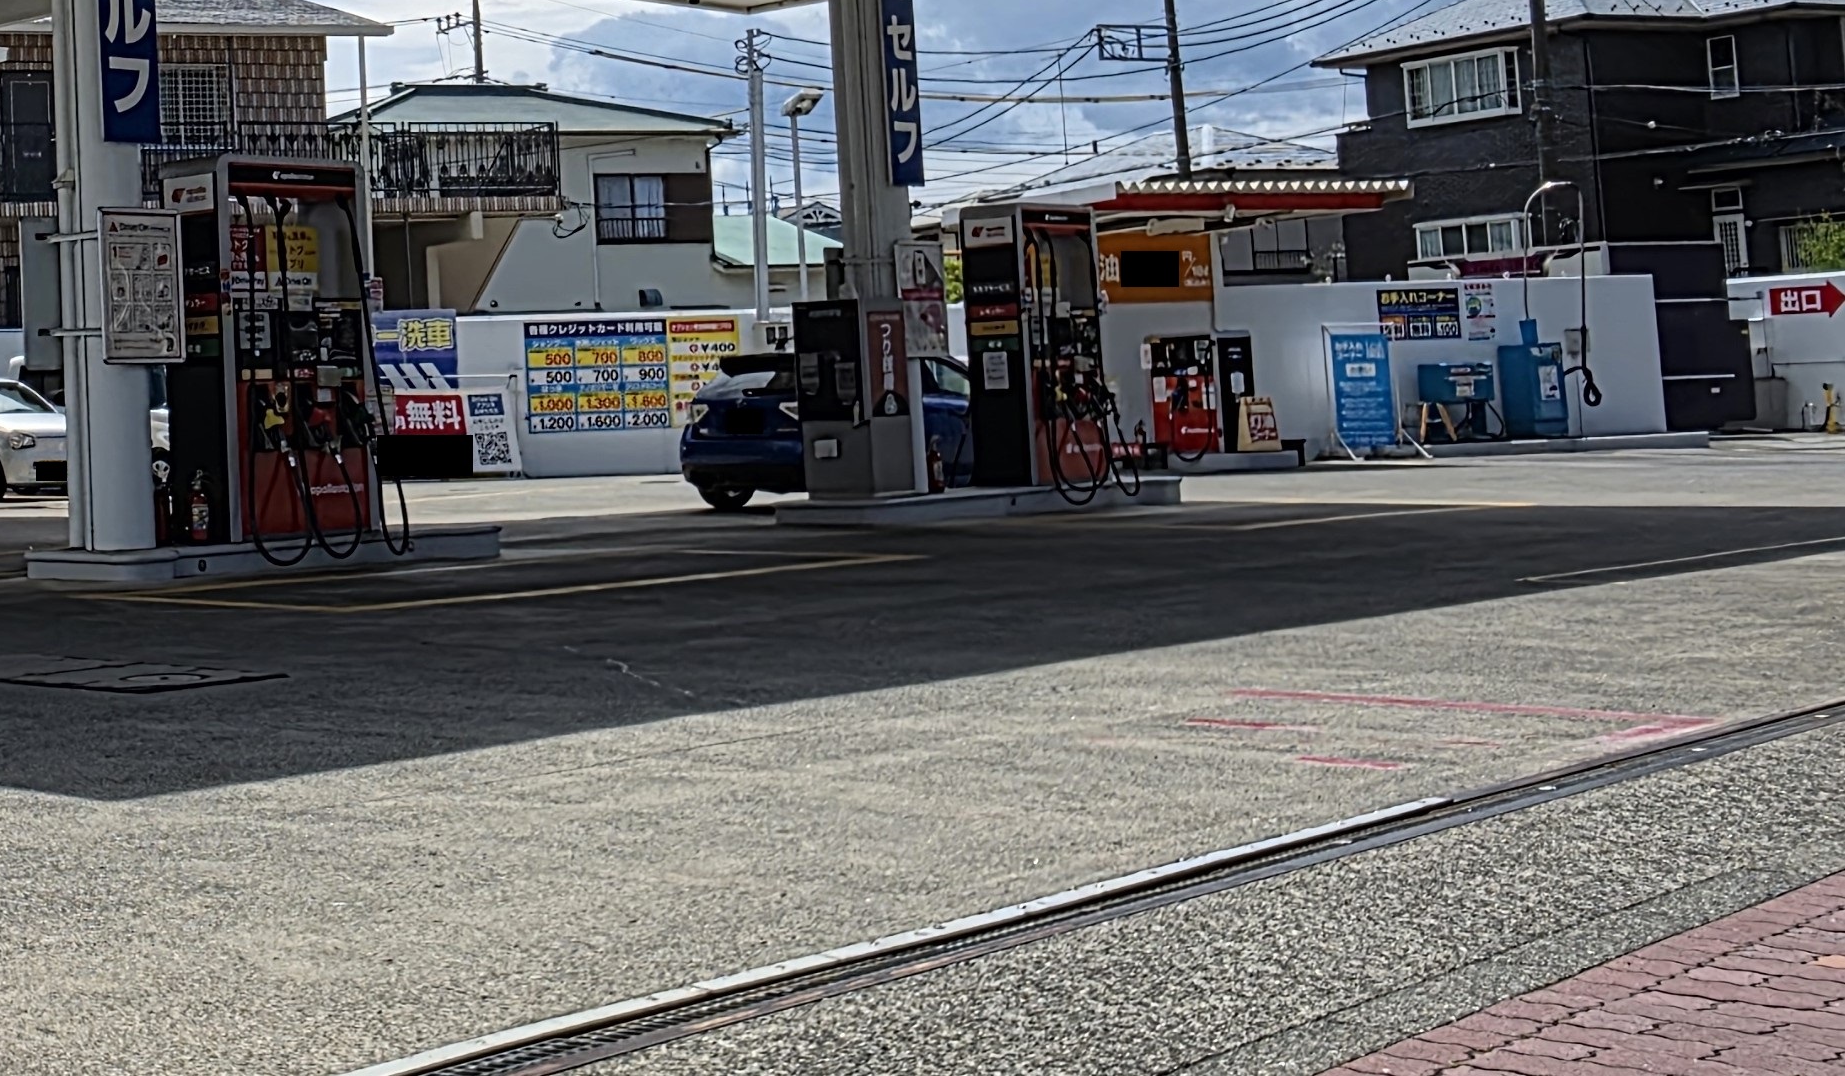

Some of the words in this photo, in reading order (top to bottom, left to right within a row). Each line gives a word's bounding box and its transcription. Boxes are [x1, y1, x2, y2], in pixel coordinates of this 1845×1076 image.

[886, 14, 918, 165] セルフ
[1780, 289, 1823, 313] 出口
